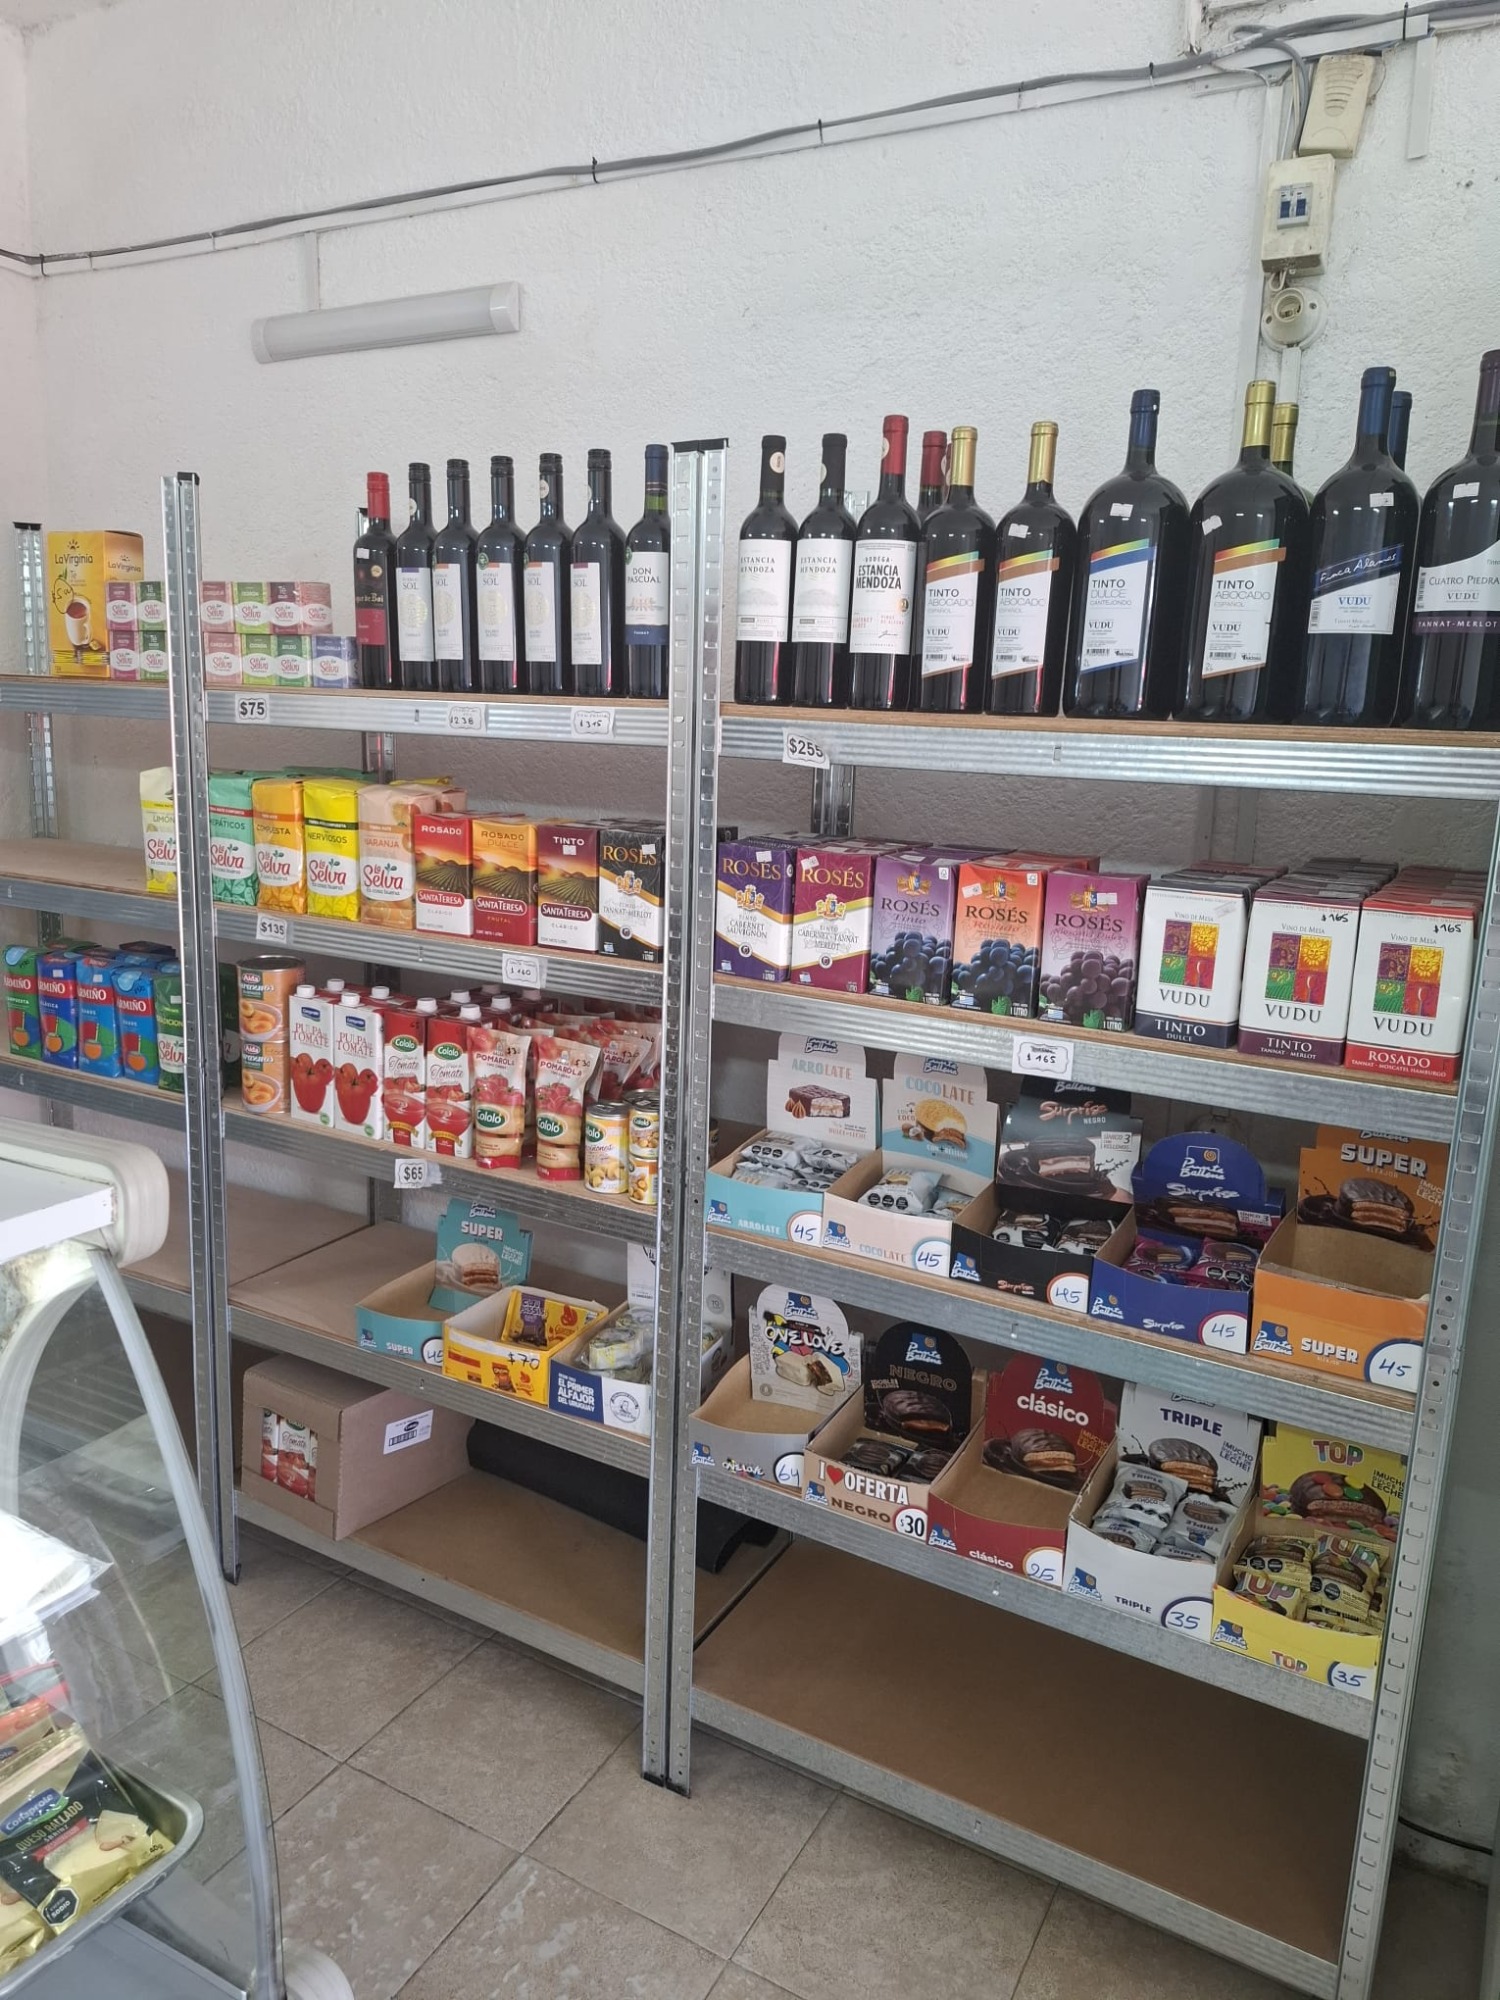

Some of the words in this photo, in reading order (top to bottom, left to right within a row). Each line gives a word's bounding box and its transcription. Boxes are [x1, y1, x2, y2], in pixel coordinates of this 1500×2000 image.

[741, 556, 775, 564] ESTANCIA
[800, 556, 837, 564] ESTANCIA
[858, 565, 898, 576] ESTANCIA
[628, 576, 661, 584] PASCUAL
[856, 577, 902, 589] MENDOZA
[1092, 579, 1125, 588] TINTO
[1217, 580, 1254, 590] TINTO
[1429, 576, 1464, 586] CUATRO
[928, 588, 959, 598] TINTO
[1000, 588, 1031, 597] TINTO
[1090, 589, 1127, 599] DULCE
[1215, 590, 1271, 600] ABOCADO
[1338, 596, 1372, 606] VUDU
[1447, 592, 1480, 600] VUDU
[1088, 621, 1113, 629] VUDU
[1212, 624, 1242, 632] VUDU
[240, 702, 265, 716] $75
[789, 737, 824, 758] $255
[308, 832, 348, 844] NERVIOSOS
[421, 824, 462, 835] ROSADO
[481, 831, 525, 841] ROSADO
[365, 837, 400, 848] NARANJA
[488, 840, 519, 849] DULCE
[553, 836, 585, 846] TINTO
[258, 851, 291, 875] Selva
[309, 859, 347, 885] Selva
[363, 864, 404, 890] Selva
[881, 897, 940, 917] ROSÉS
[966, 905, 1029, 924] ROSÉS
[260, 922, 284, 935] $135
[730, 919, 765, 931] CABERNET
[1054, 913, 1123, 932] ROSÉS
[1160, 989, 1210, 1008] VUDU
[1265, 1004, 1321, 1023] VUDU
[1154, 1019, 1206, 1036] TINTO
[1373, 1017, 1434, 1037] VUDU
[292, 1030, 329, 1047] TOMATE
[1166, 1033, 1192, 1042] DULCE
[1267, 1038, 1312, 1052] TINTO
[336, 1041, 374, 1057] TOMATE
[1261, 1047, 1285, 1055] TANNAT
[1290, 1052, 1316, 1060] MERLOT
[1368, 1050, 1431, 1068] ROSADO
[540, 1061, 582, 1077] POMAROLA
[792, 1058, 854, 1081] ARROLATE
[1352, 1059, 1375, 1067] TANNAT
[1379, 1064, 1409, 1072] MOSCATEL
[1410, 1068, 1446, 1077] HAMBURGO
[905, 1075, 976, 1106] COCOLATE
[1038, 1100, 1108, 1125] Surprise
[1083, 1116, 1106, 1125] NEGRO
[1123, 1134, 1130, 1145] 3
[1340, 1142, 1428, 1179] SUPER
[404, 1166, 423, 1181] $65
[1179, 1167, 1226, 1180] Ballena
[1166, 1182, 1240, 1201] Surprise
[461, 1221, 504, 1241] SUPER
[738, 1219, 780, 1235] ARROLATE
[794, 1224, 819, 1241] 45
[918, 1251, 943, 1268] 45
[1055, 1286, 1083, 1304] 45
[1142, 1318, 1185, 1332] Surprise
[1211, 1323, 1237, 1338] 45
[385, 1342, 413, 1355] SUPER
[1301, 1337, 1360, 1365] SUPER
[507, 1352, 540, 1370] $70
[1378, 1357, 1413, 1377] 45
[889, 1364, 957, 1391] NEGRO
[558, 1378, 566, 1386] EL
[567, 1380, 594, 1396] PRIMER
[558, 1387, 594, 1405] ALFAJOR
[558, 1396, 568, 1404] DEL
[568, 1400, 594, 1412] URUGUAY
[1016, 1393, 1089, 1427] clásico
[1160, 1408, 1224, 1436] TRIPLE
[1223, 1440, 1255, 1461] ¡MUCHO
[1312, 1439, 1365, 1468] TOP
[778, 1465, 800, 1488] 64
[819, 1459, 825, 1480] I
[844, 1472, 910, 1505] OFERTA
[1131, 1472, 1163, 1484] TRIPLE
[831, 1497, 891, 1524] NEGRO
[900, 1515, 925, 1537] $30
[969, 1549, 1014, 1570] clásico
[1114, 1596, 1152, 1614] TRIPLE
[1168, 1611, 1200, 1630] 35
[1271, 1650, 1309, 1674] TOP
[1334, 1670, 1367, 1688] 35
[5, 1792, 55, 1831] Conaprole
[16, 1830, 46, 1851] QUESO
[46, 1800, 84, 1833] RALLADO
[51, 1900, 71, 1917] SODIO
